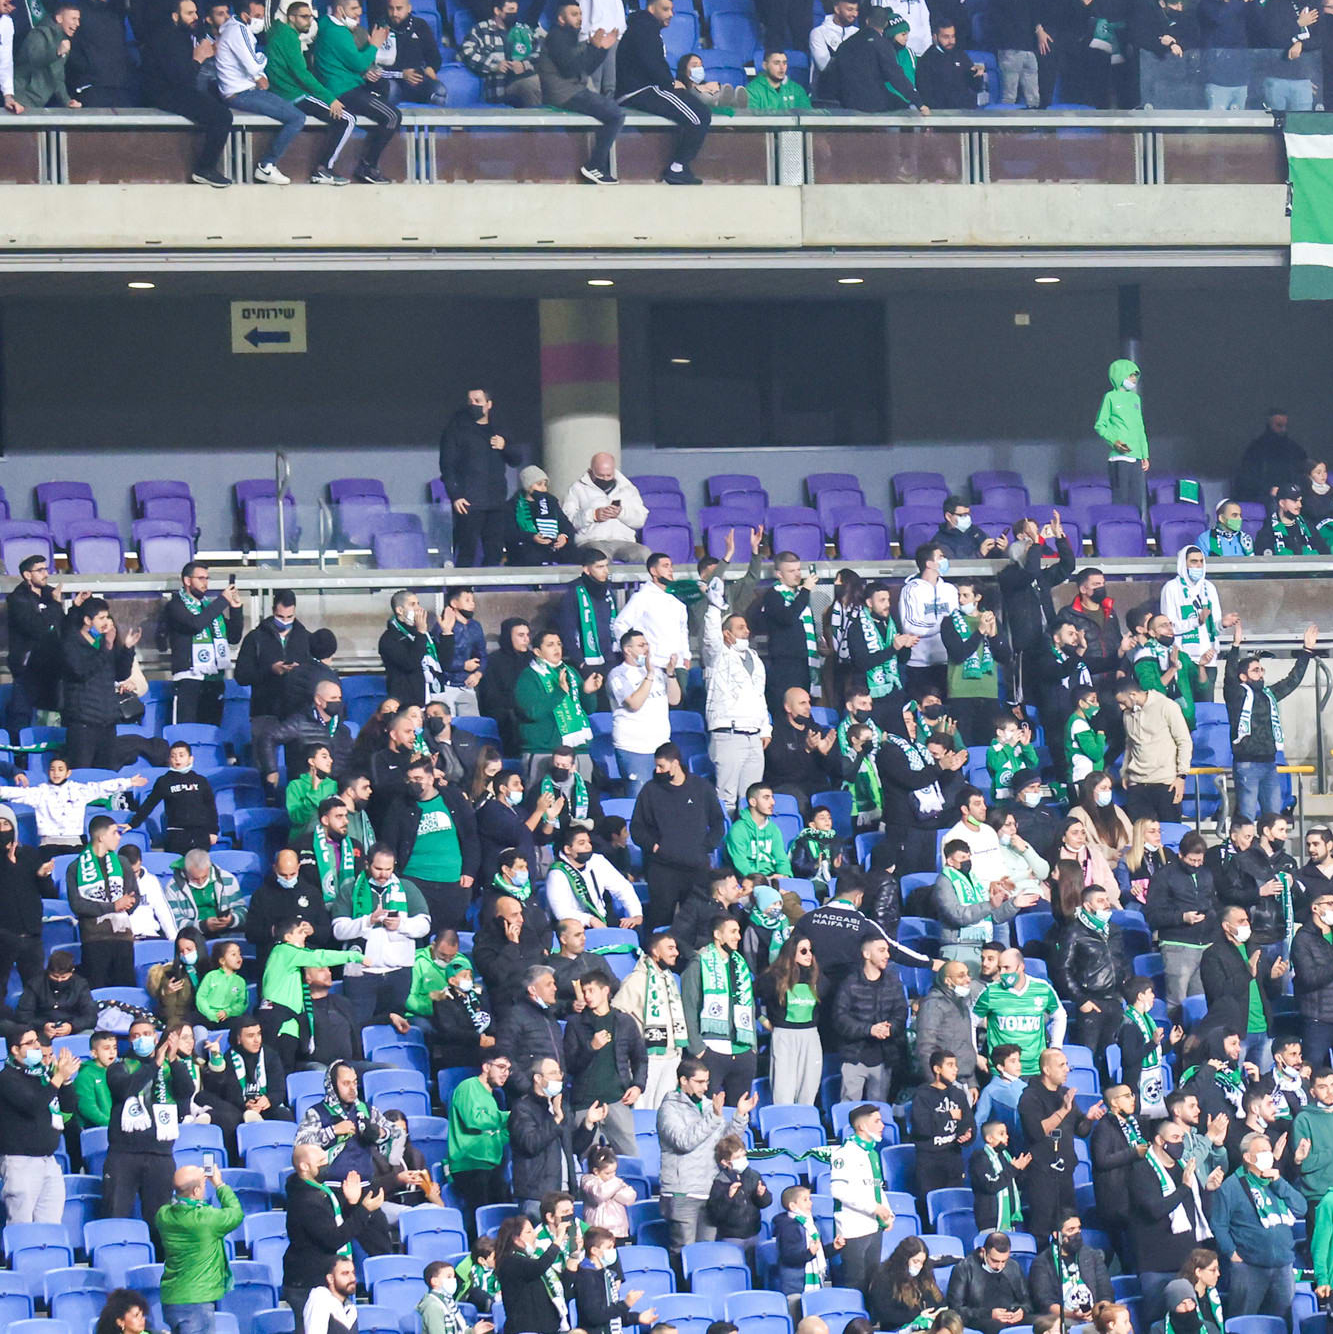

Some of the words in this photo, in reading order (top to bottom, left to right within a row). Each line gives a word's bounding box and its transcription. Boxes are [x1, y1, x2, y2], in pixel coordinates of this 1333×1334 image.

[241, 307, 295, 319] שירותים
[170, 783, 199, 793] REPLAY
[812, 919, 843, 928] HAIFA
[846, 923, 859, 931] FC
[813, 913, 860, 925] MACCABI
[996, 1015, 1042, 1032] VOLVO
